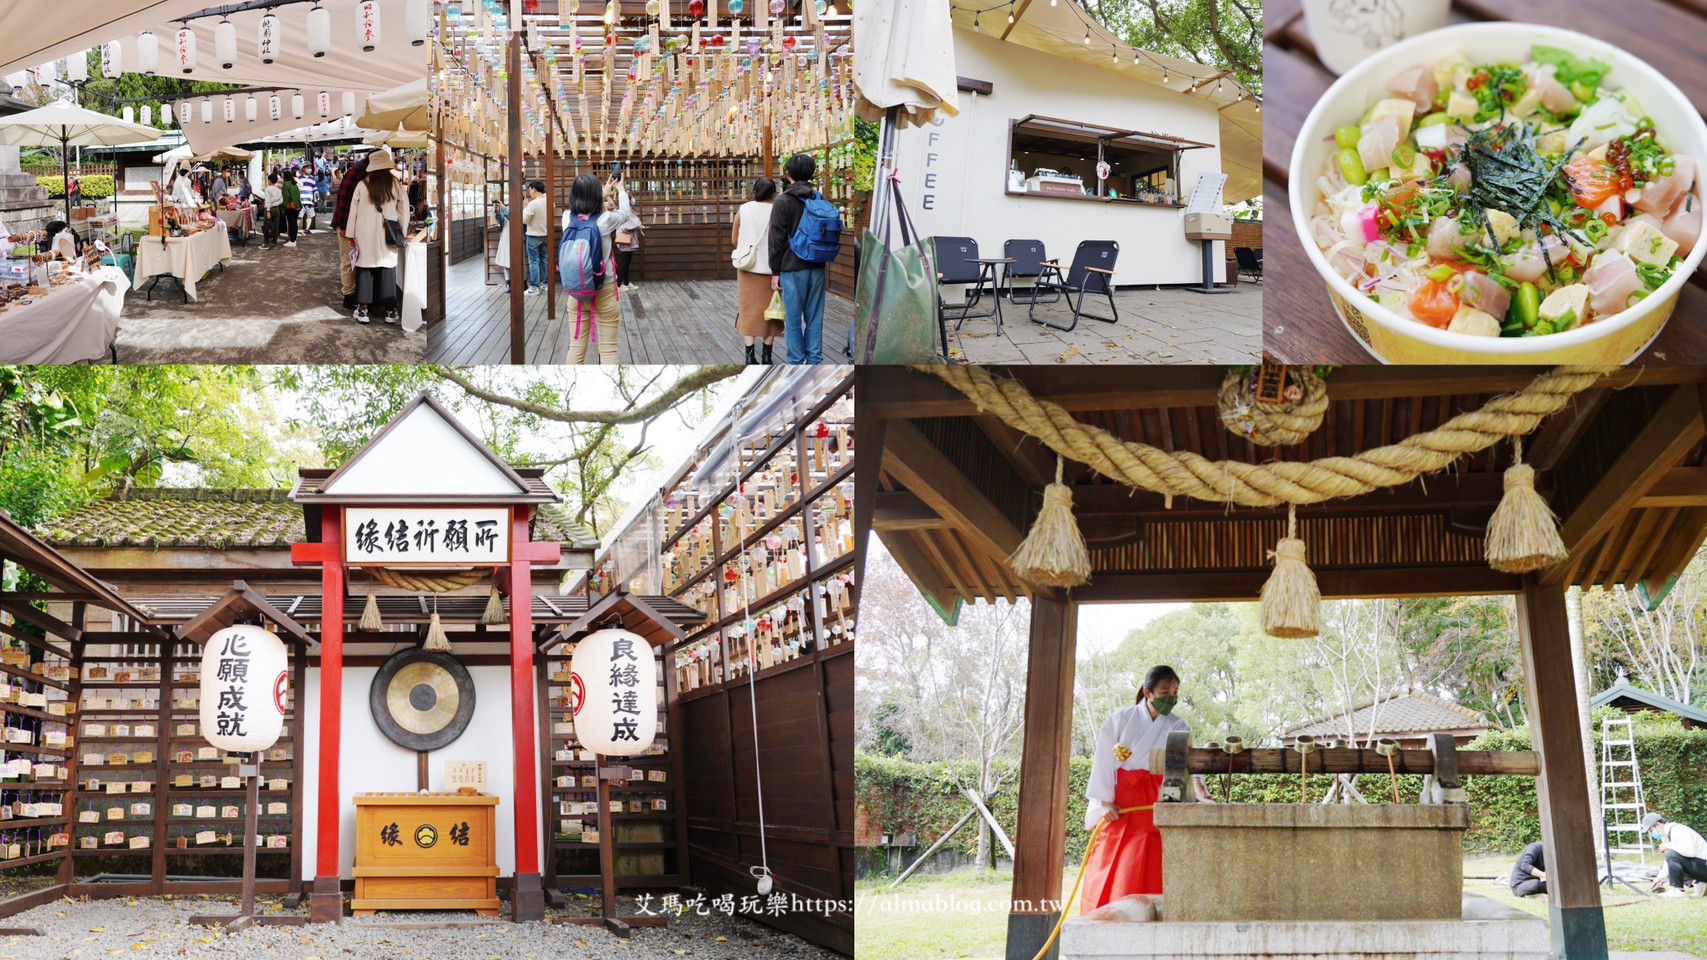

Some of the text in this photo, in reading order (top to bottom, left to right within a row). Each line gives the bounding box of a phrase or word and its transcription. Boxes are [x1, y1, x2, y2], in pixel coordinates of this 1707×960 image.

[216, 633, 252, 737] 心願成就
[449, 821, 470, 846] 結
